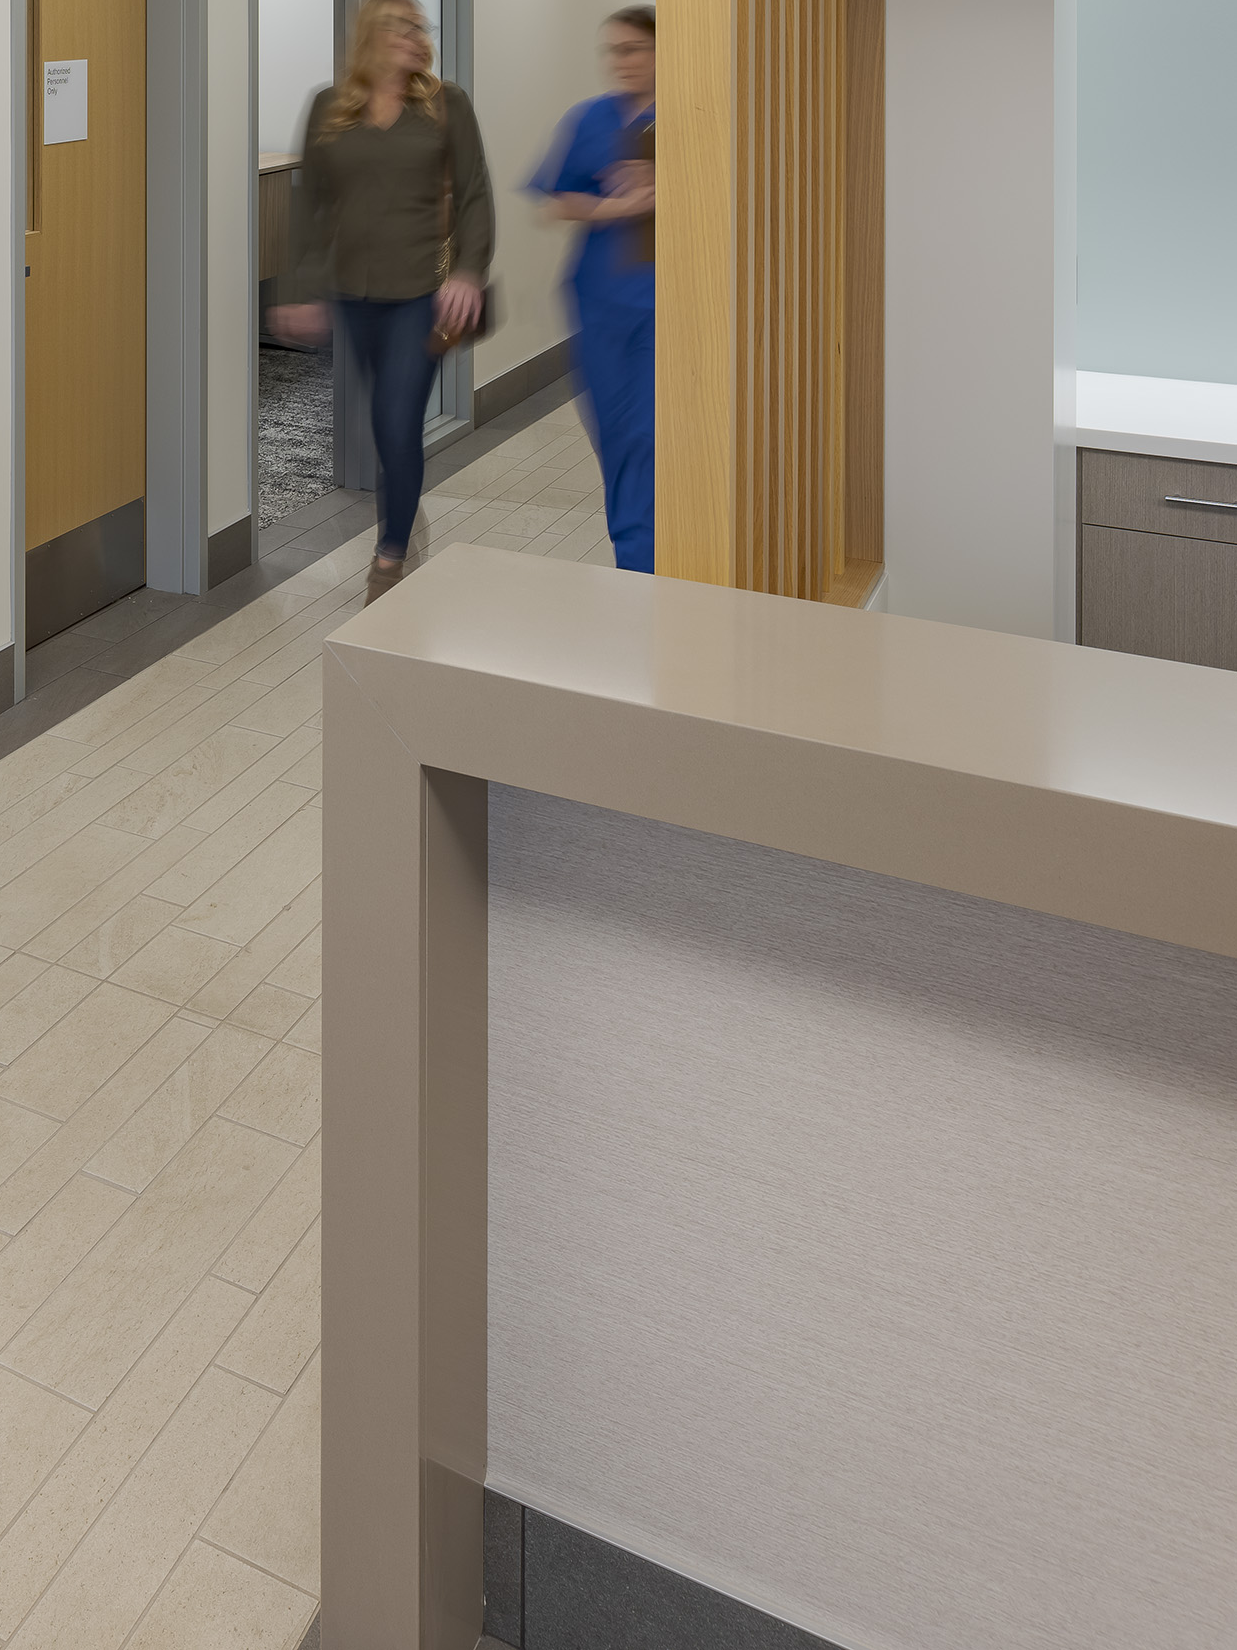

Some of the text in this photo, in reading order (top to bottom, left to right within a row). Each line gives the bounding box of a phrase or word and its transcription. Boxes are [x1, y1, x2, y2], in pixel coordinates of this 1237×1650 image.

[47, 67, 71, 76] Authorized
[47, 77, 69, 86] Personnel
[47, 87, 58, 96] Only
